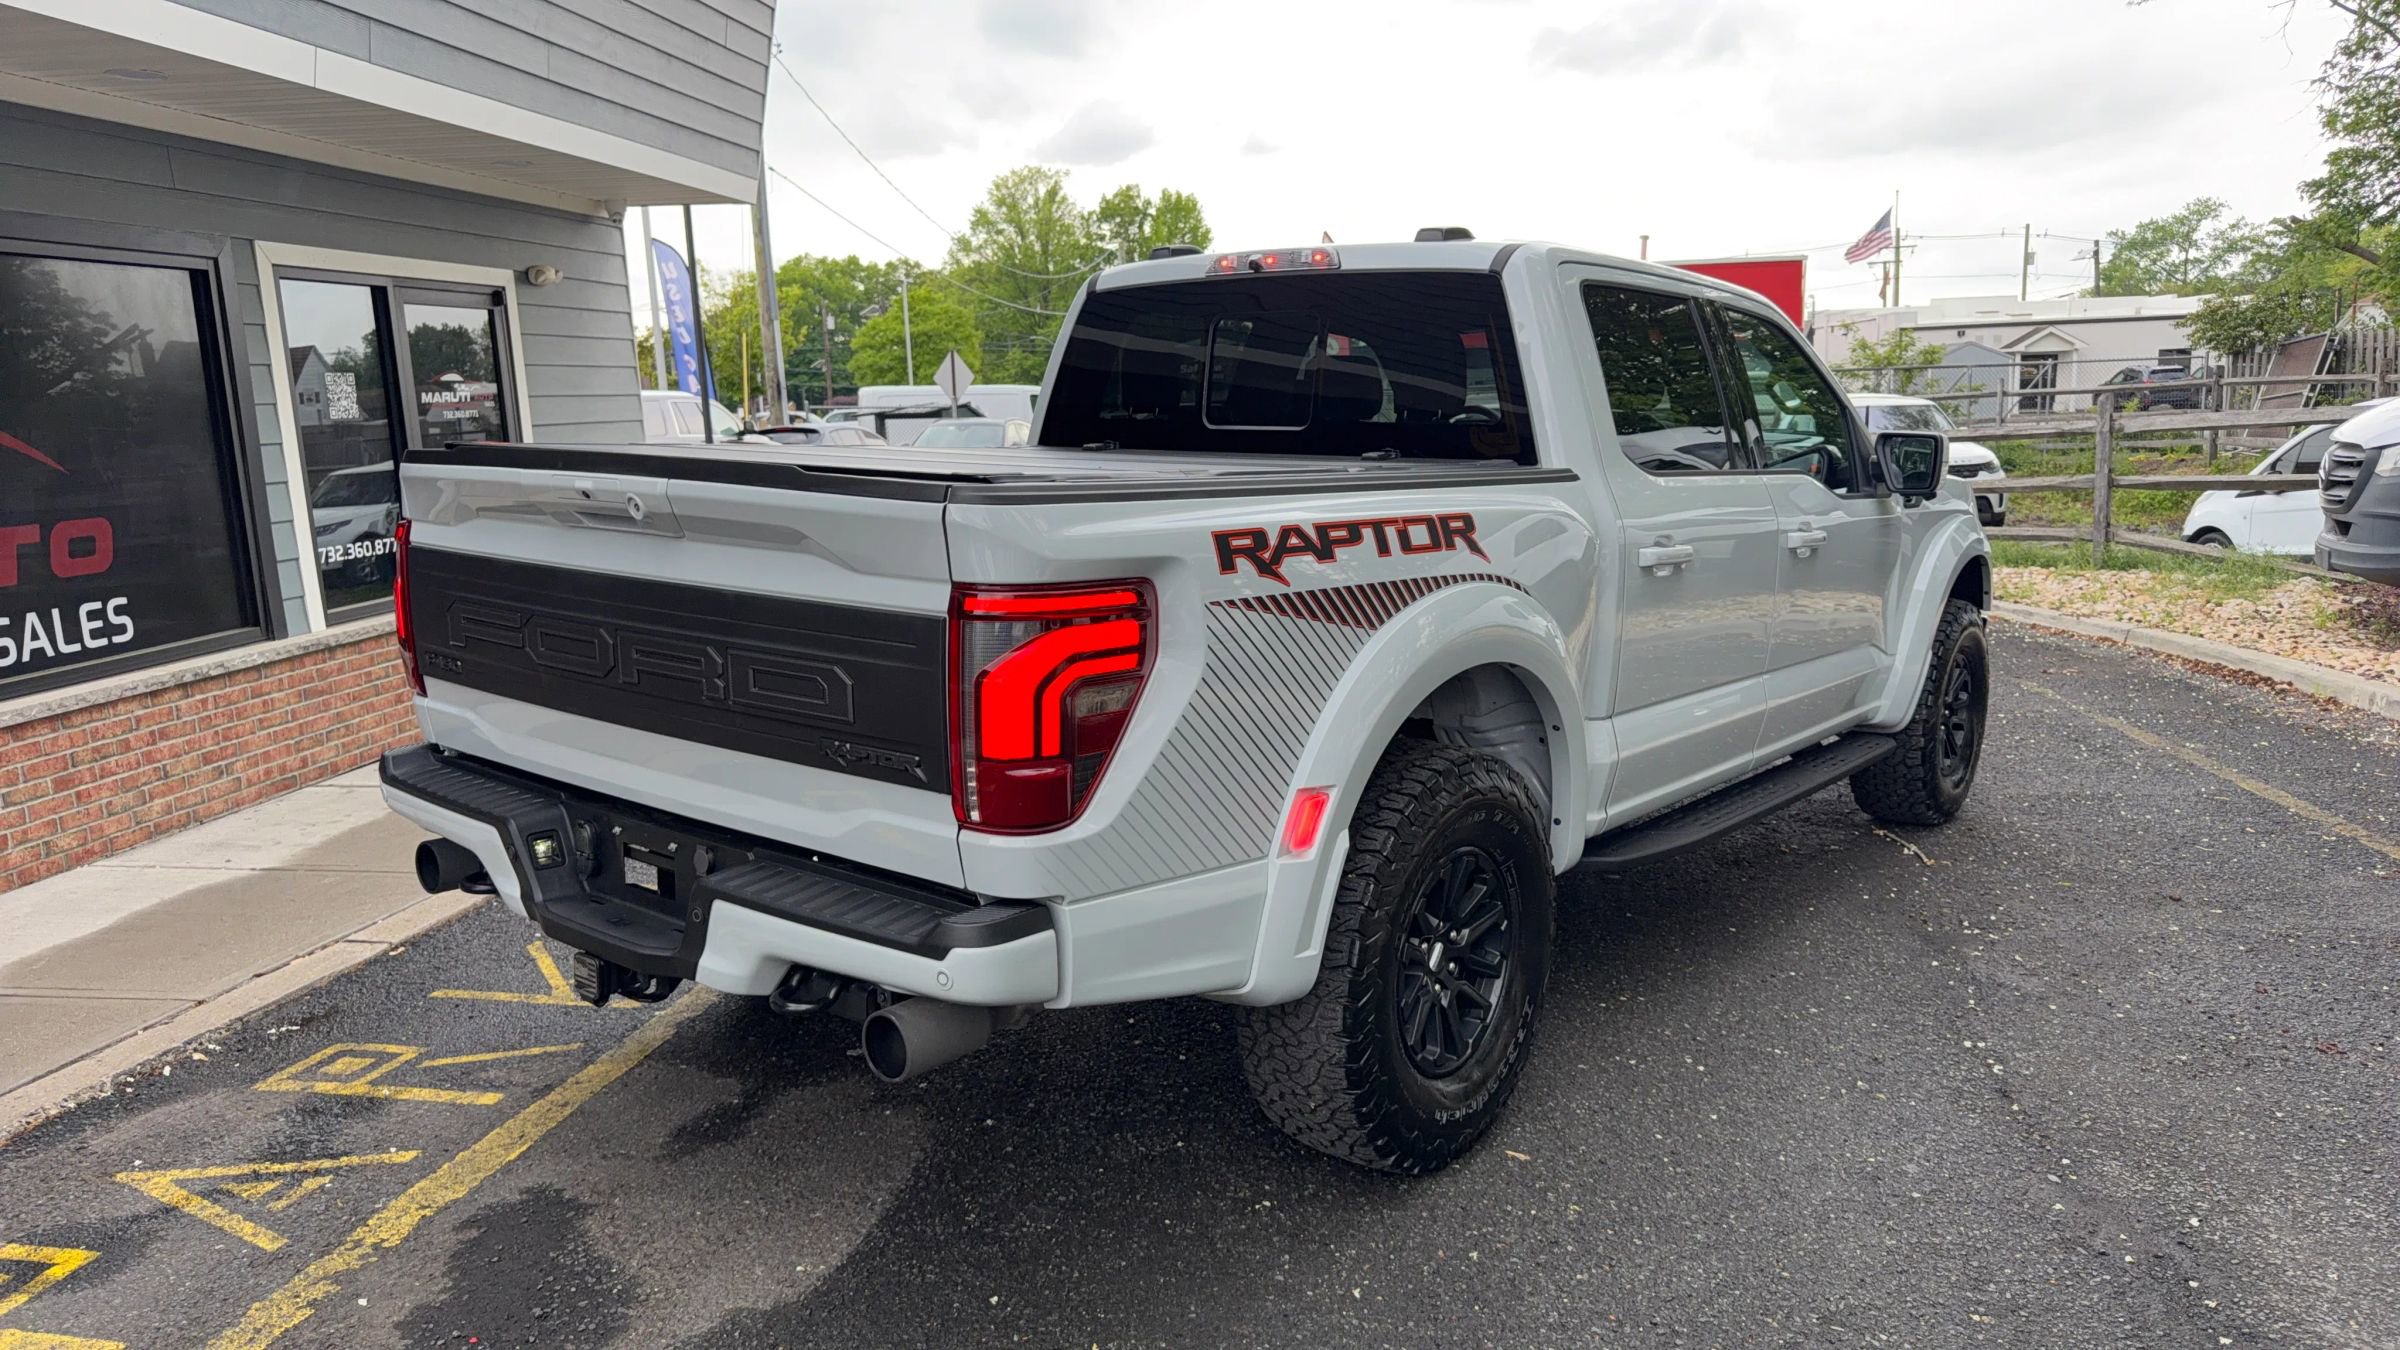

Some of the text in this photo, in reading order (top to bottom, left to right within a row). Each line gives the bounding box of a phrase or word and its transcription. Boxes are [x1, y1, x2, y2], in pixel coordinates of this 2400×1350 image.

[420, 391, 471, 403] MARUTI
[1211, 512, 1491, 587] RAPTOR
[0, 597, 135, 667] SALES
[446, 599, 856, 724] FORD
[819, 736, 929, 784] RAPTOR
